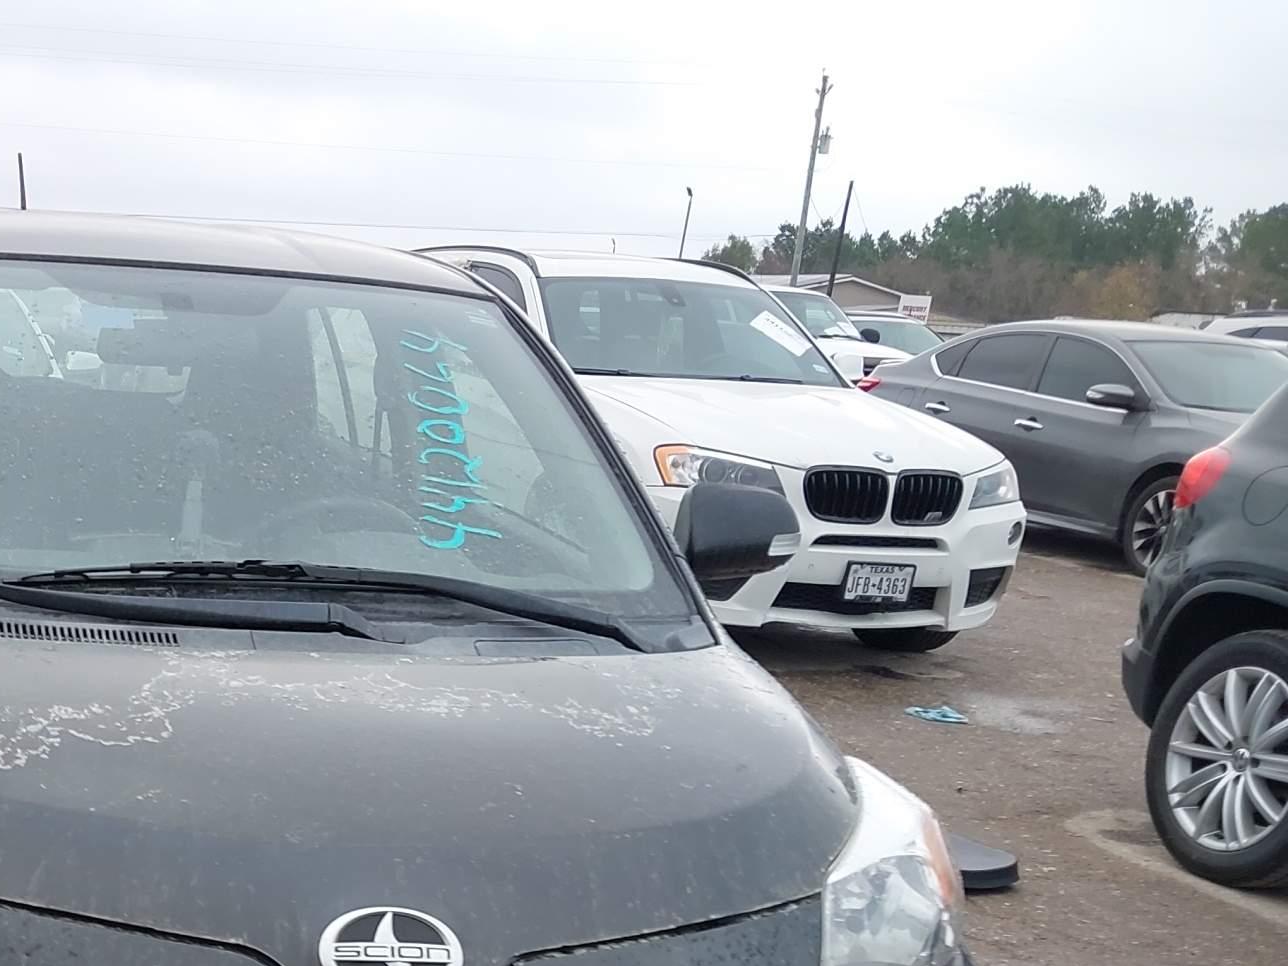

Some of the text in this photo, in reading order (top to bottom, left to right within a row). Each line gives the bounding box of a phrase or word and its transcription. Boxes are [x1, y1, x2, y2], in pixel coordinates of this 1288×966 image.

[399, 328, 503, 550] 44120064
[869, 566, 895, 574] TEXAS
[333, 944, 452, 960] SCION
